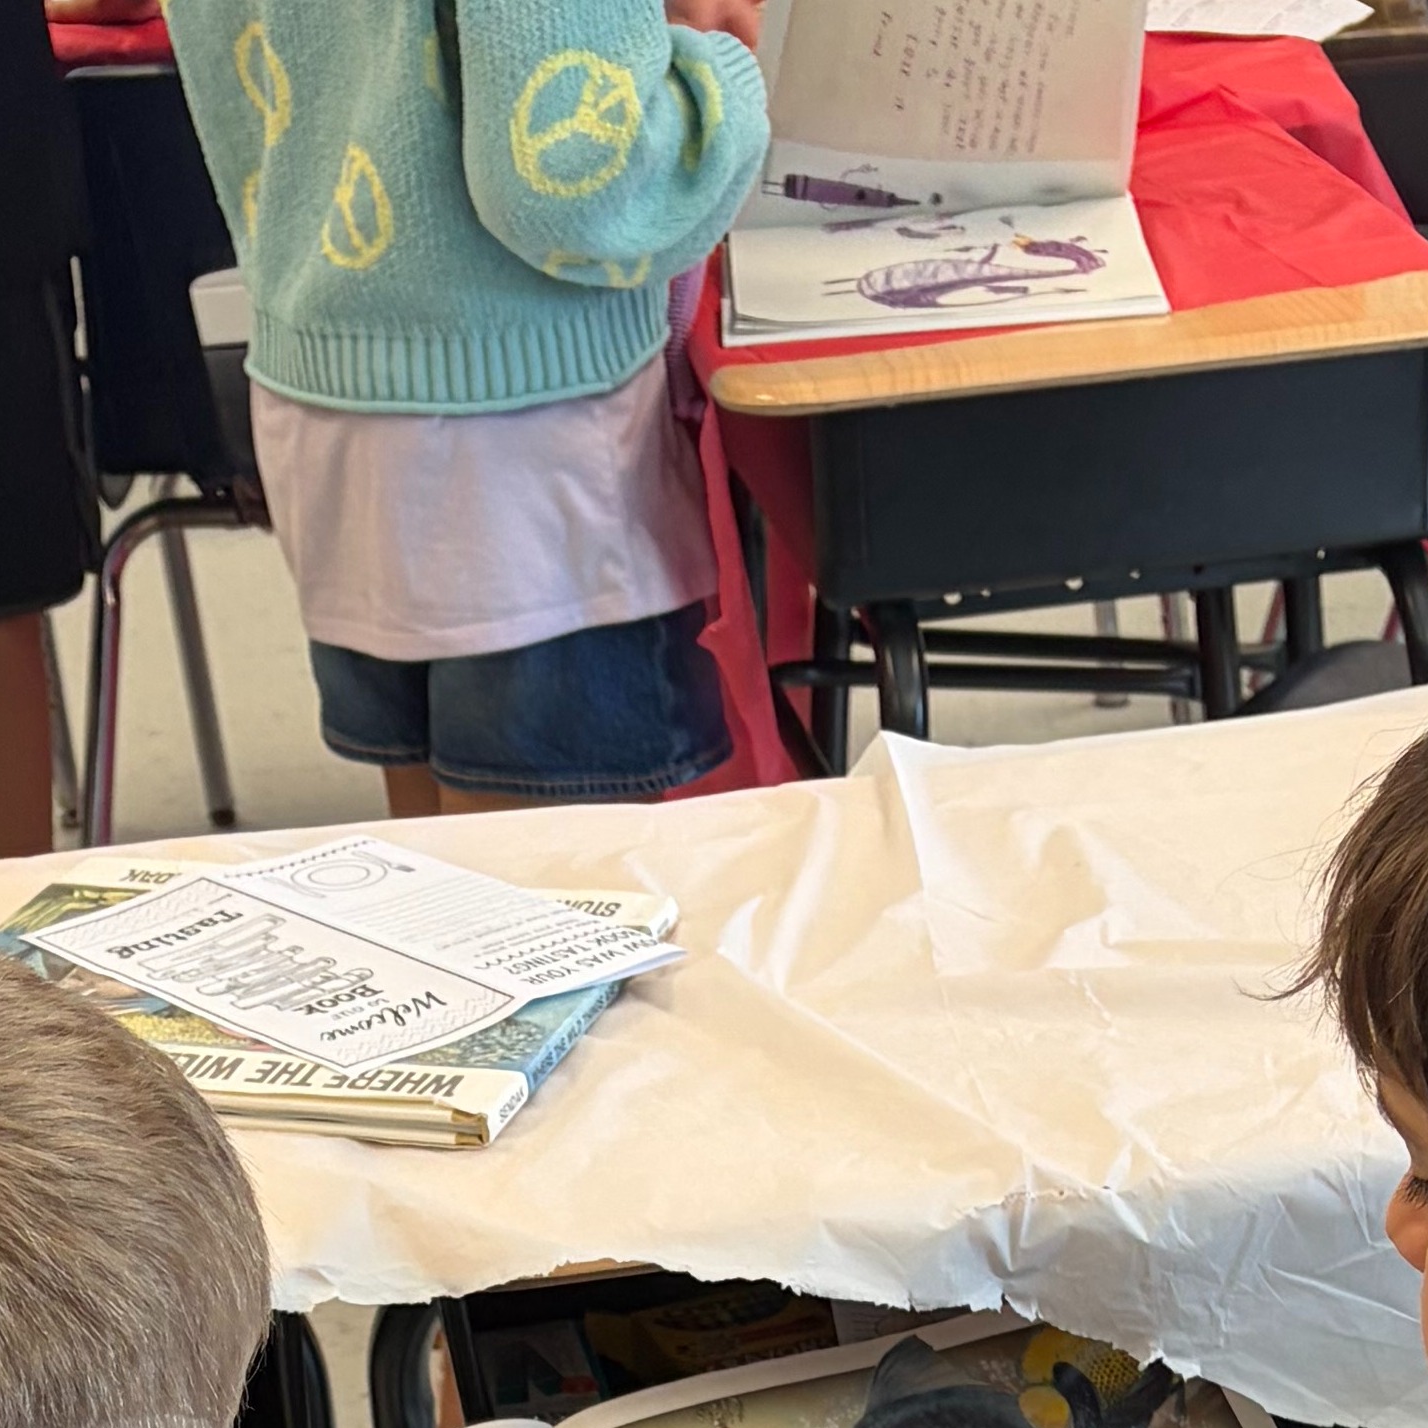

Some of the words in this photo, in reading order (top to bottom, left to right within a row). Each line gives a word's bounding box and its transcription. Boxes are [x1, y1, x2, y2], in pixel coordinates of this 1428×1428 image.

[104, 909, 243, 959] Tasting
[318, 991, 446, 1041] Welcome
[250, 1059, 323, 1087] THE
